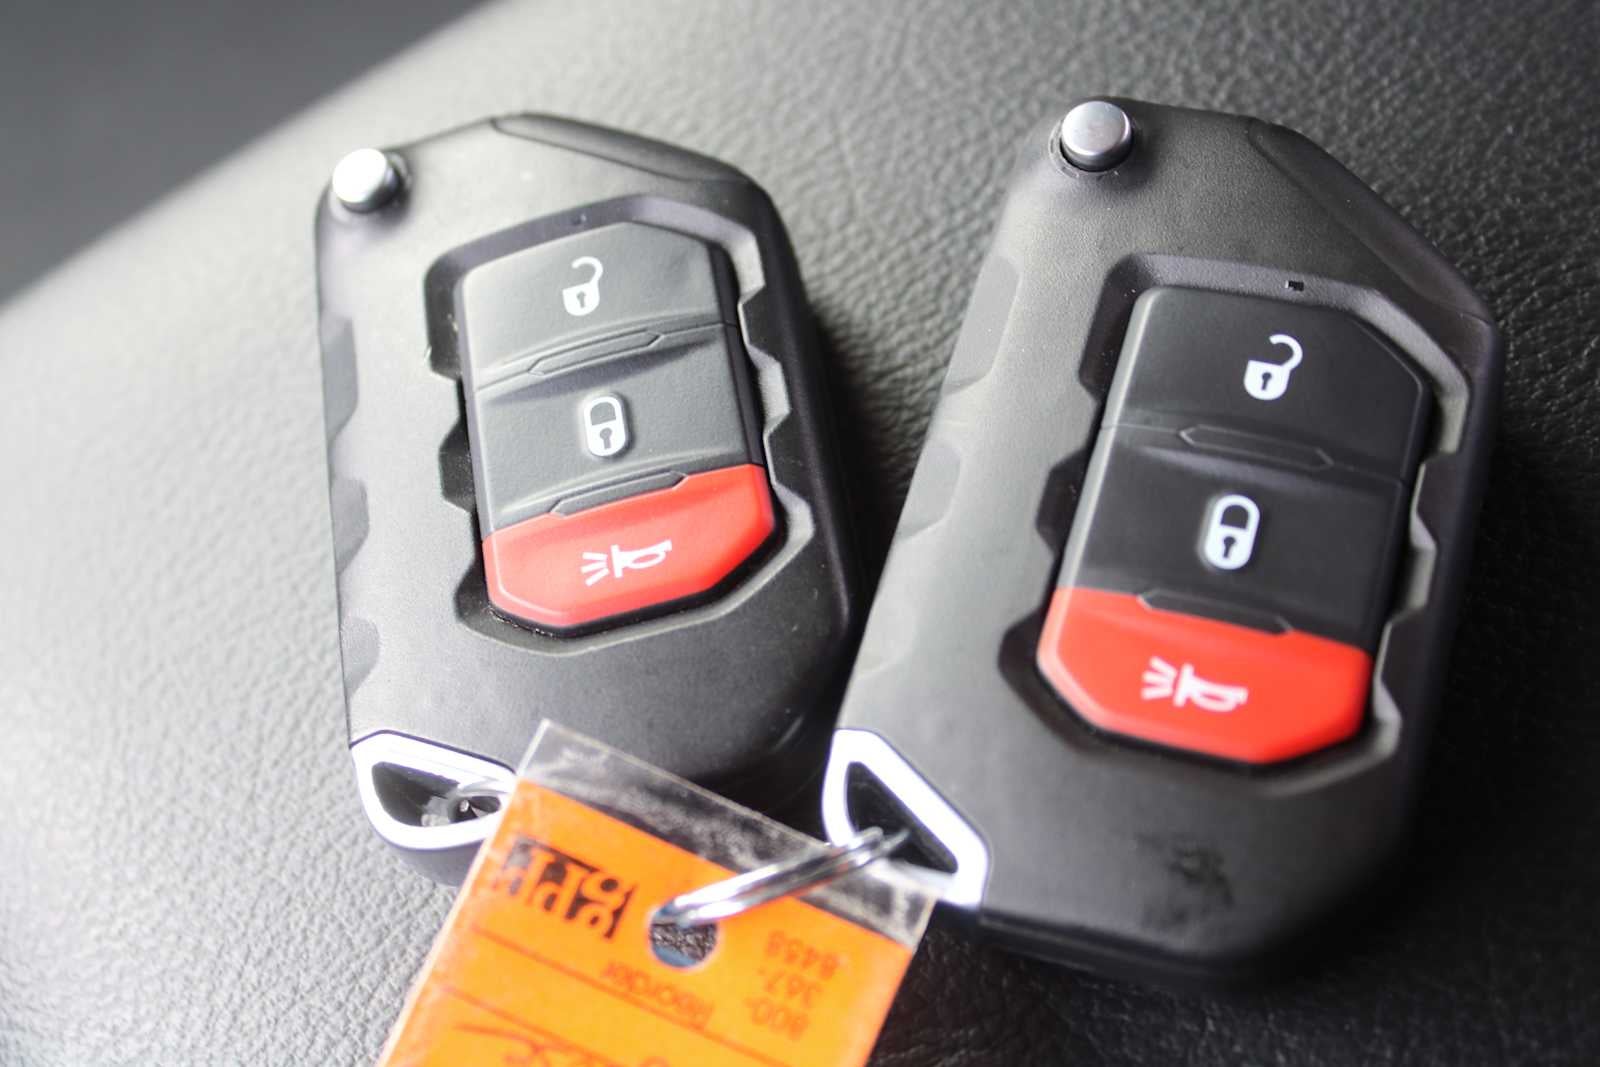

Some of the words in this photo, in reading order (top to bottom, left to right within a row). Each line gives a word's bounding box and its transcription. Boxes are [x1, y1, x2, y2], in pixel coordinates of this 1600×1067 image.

[602, 962, 716, 1029] Reorder
[757, 968, 823, 1008] 367-
[742, 996, 809, 1040] 800-
